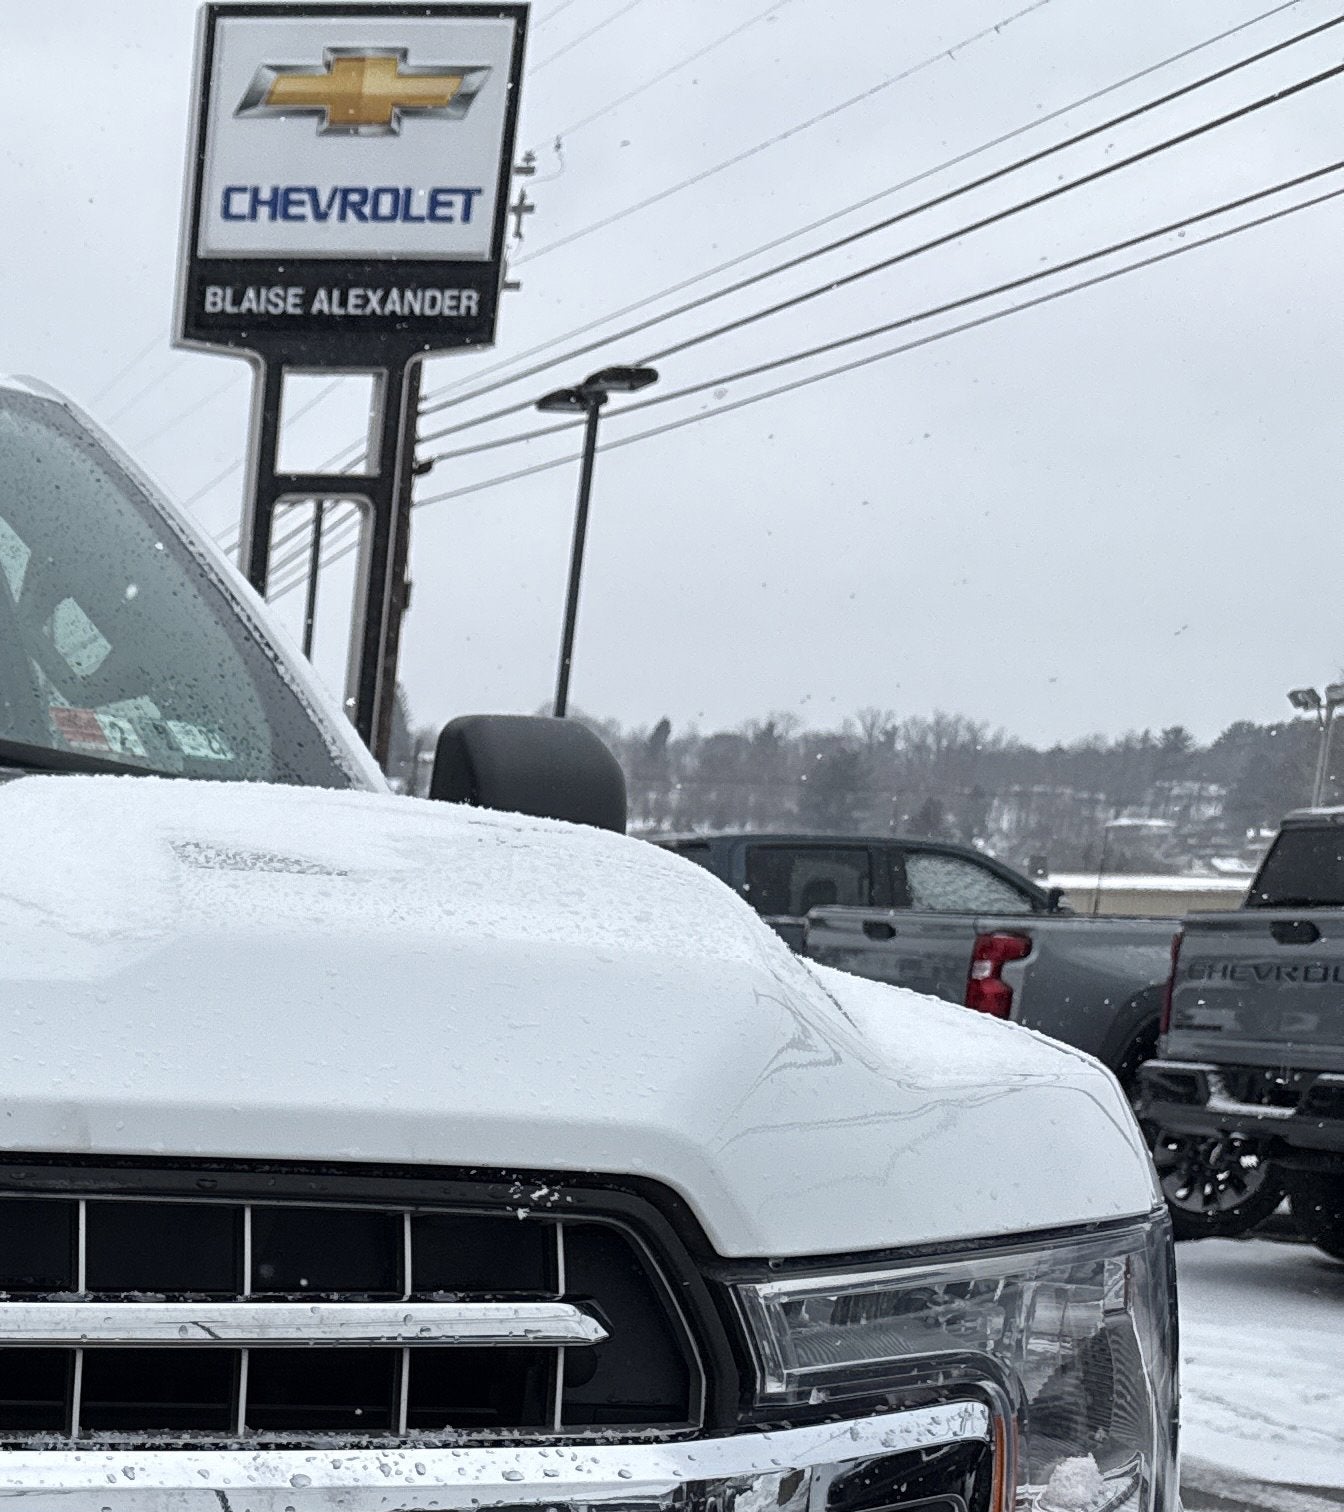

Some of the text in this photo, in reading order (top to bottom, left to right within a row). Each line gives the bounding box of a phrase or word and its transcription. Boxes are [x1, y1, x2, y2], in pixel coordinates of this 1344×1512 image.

[220, 184, 483, 225] CHEVROLET
[204, 285, 481, 318] BLAISE ALEXANDER
